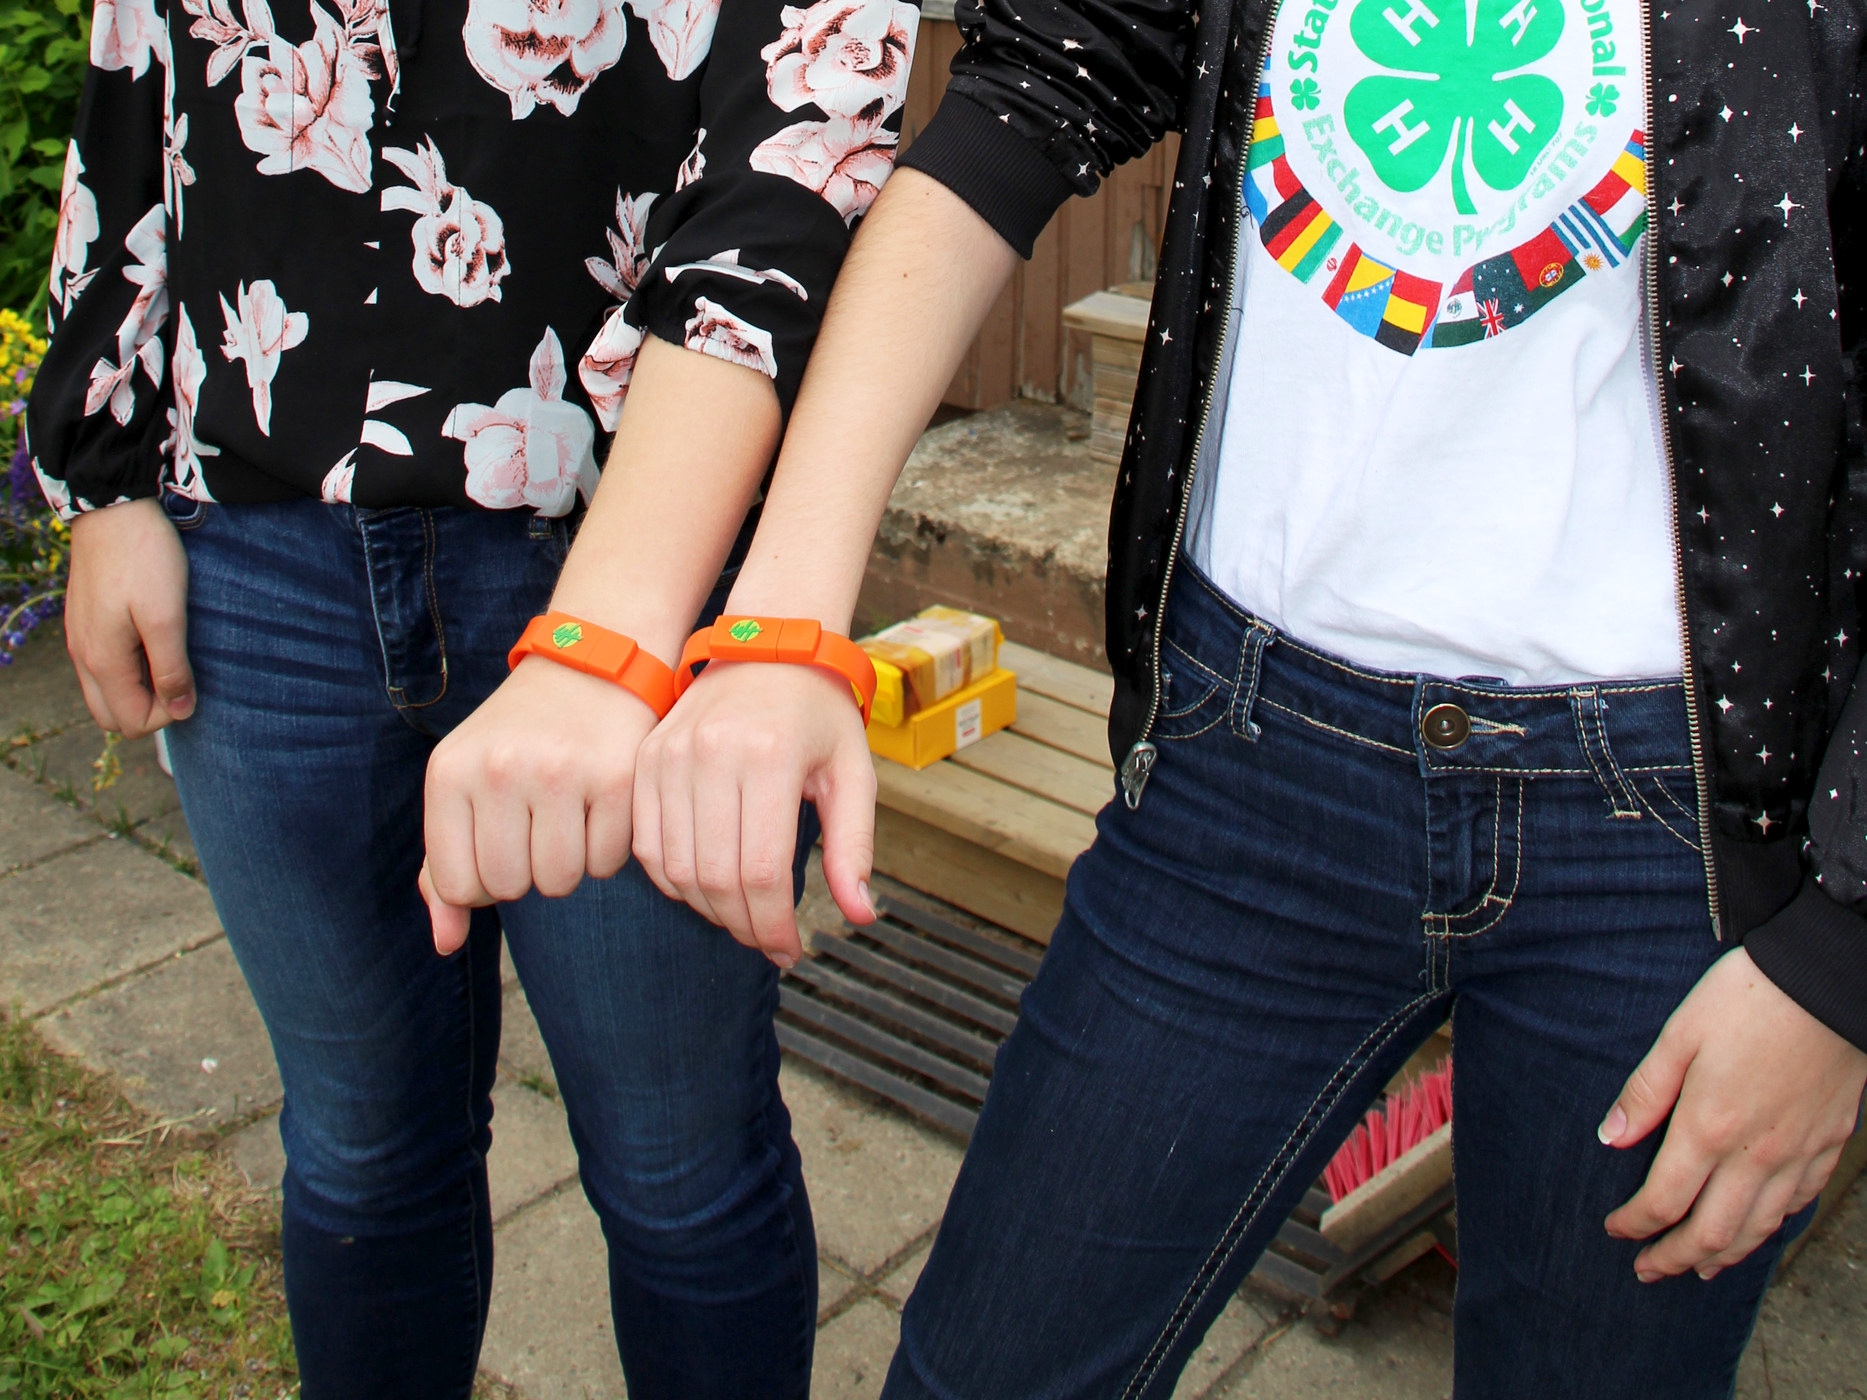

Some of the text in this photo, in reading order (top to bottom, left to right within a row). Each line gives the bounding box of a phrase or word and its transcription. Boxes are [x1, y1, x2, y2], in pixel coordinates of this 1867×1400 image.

[1371, 98, 1431, 156] H
[1487, 98, 1536, 156] H
[1302, 113, 1444, 256] Exchange
